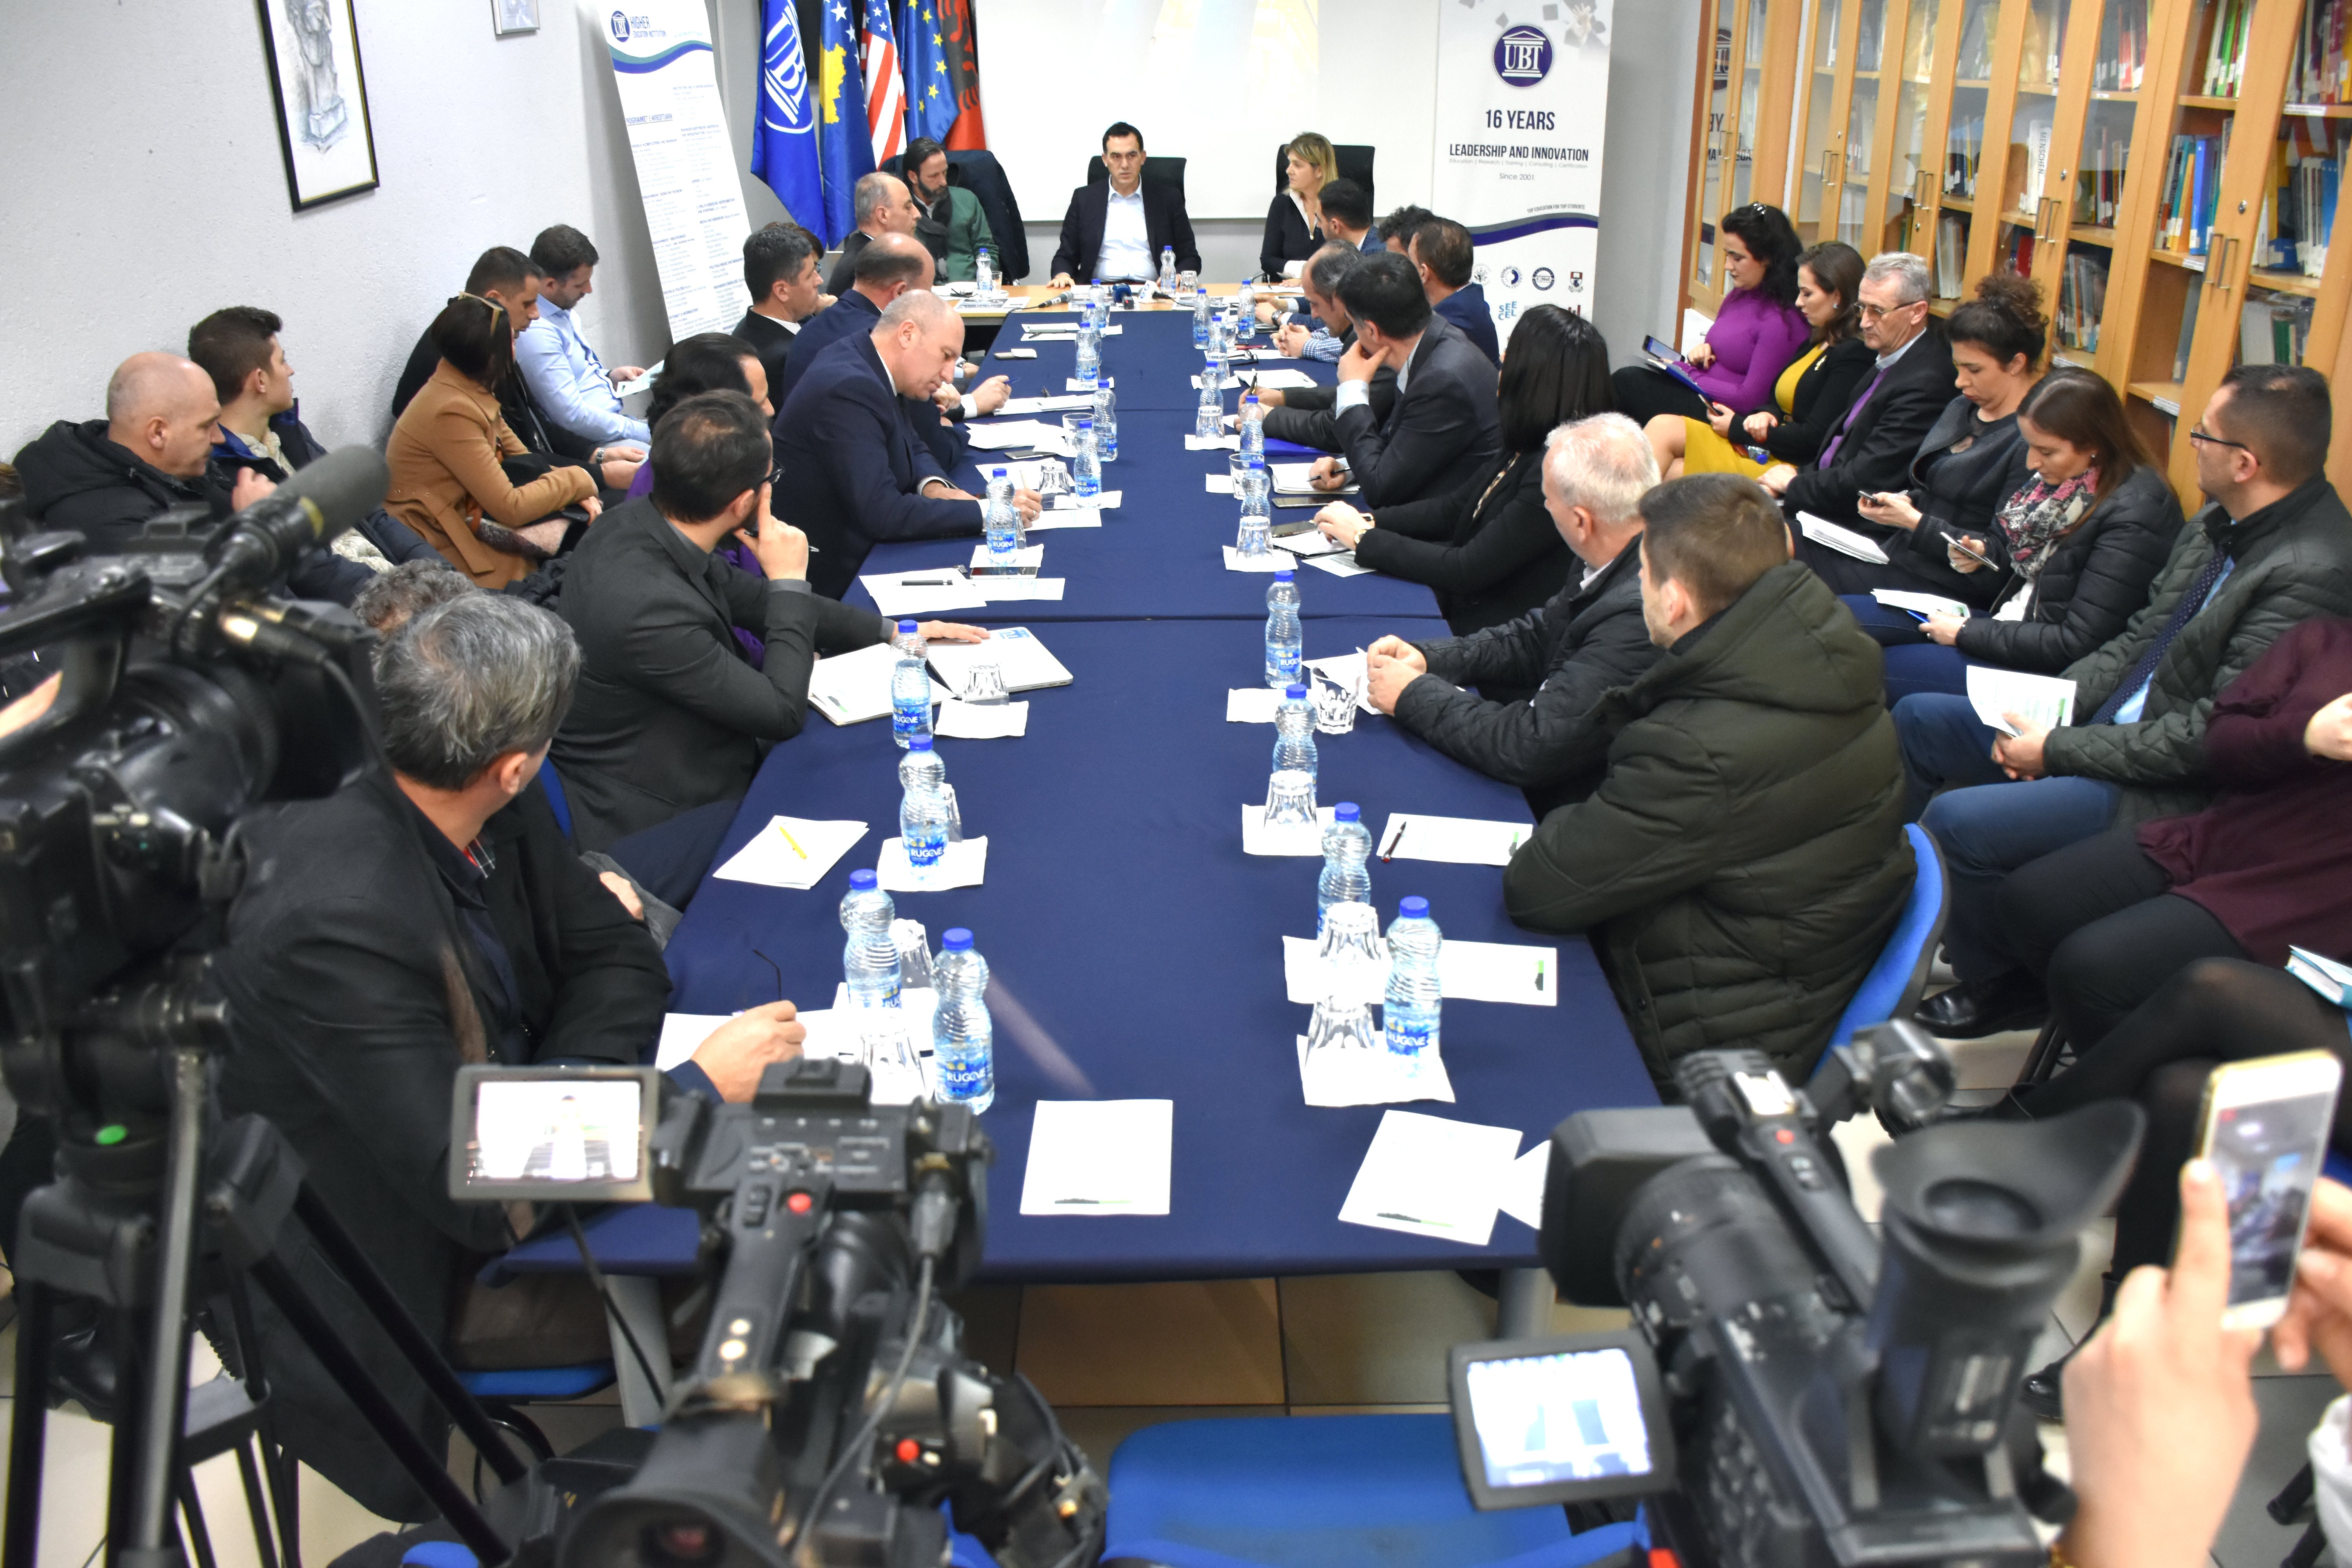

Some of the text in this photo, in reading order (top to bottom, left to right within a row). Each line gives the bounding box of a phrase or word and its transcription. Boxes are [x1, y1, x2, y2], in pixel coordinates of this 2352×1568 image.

[613, 20, 627, 34] UBT
[630, 16, 650, 29] HIGHER
[1505, 45, 1543, 70] UBT
[1486, 110, 1555, 131] 16 YEARS
[1450, 144, 1589, 161] LEADERSHIP AND INNOVATION
[1499, 301, 1517, 313] SEE
[1498, 309, 1517, 320] CEL
[911, 847, 943, 857] RUGOVE
[1388, 1031, 1426, 1046] RUGOVE
[947, 1067, 985, 1082] RUGOVE
